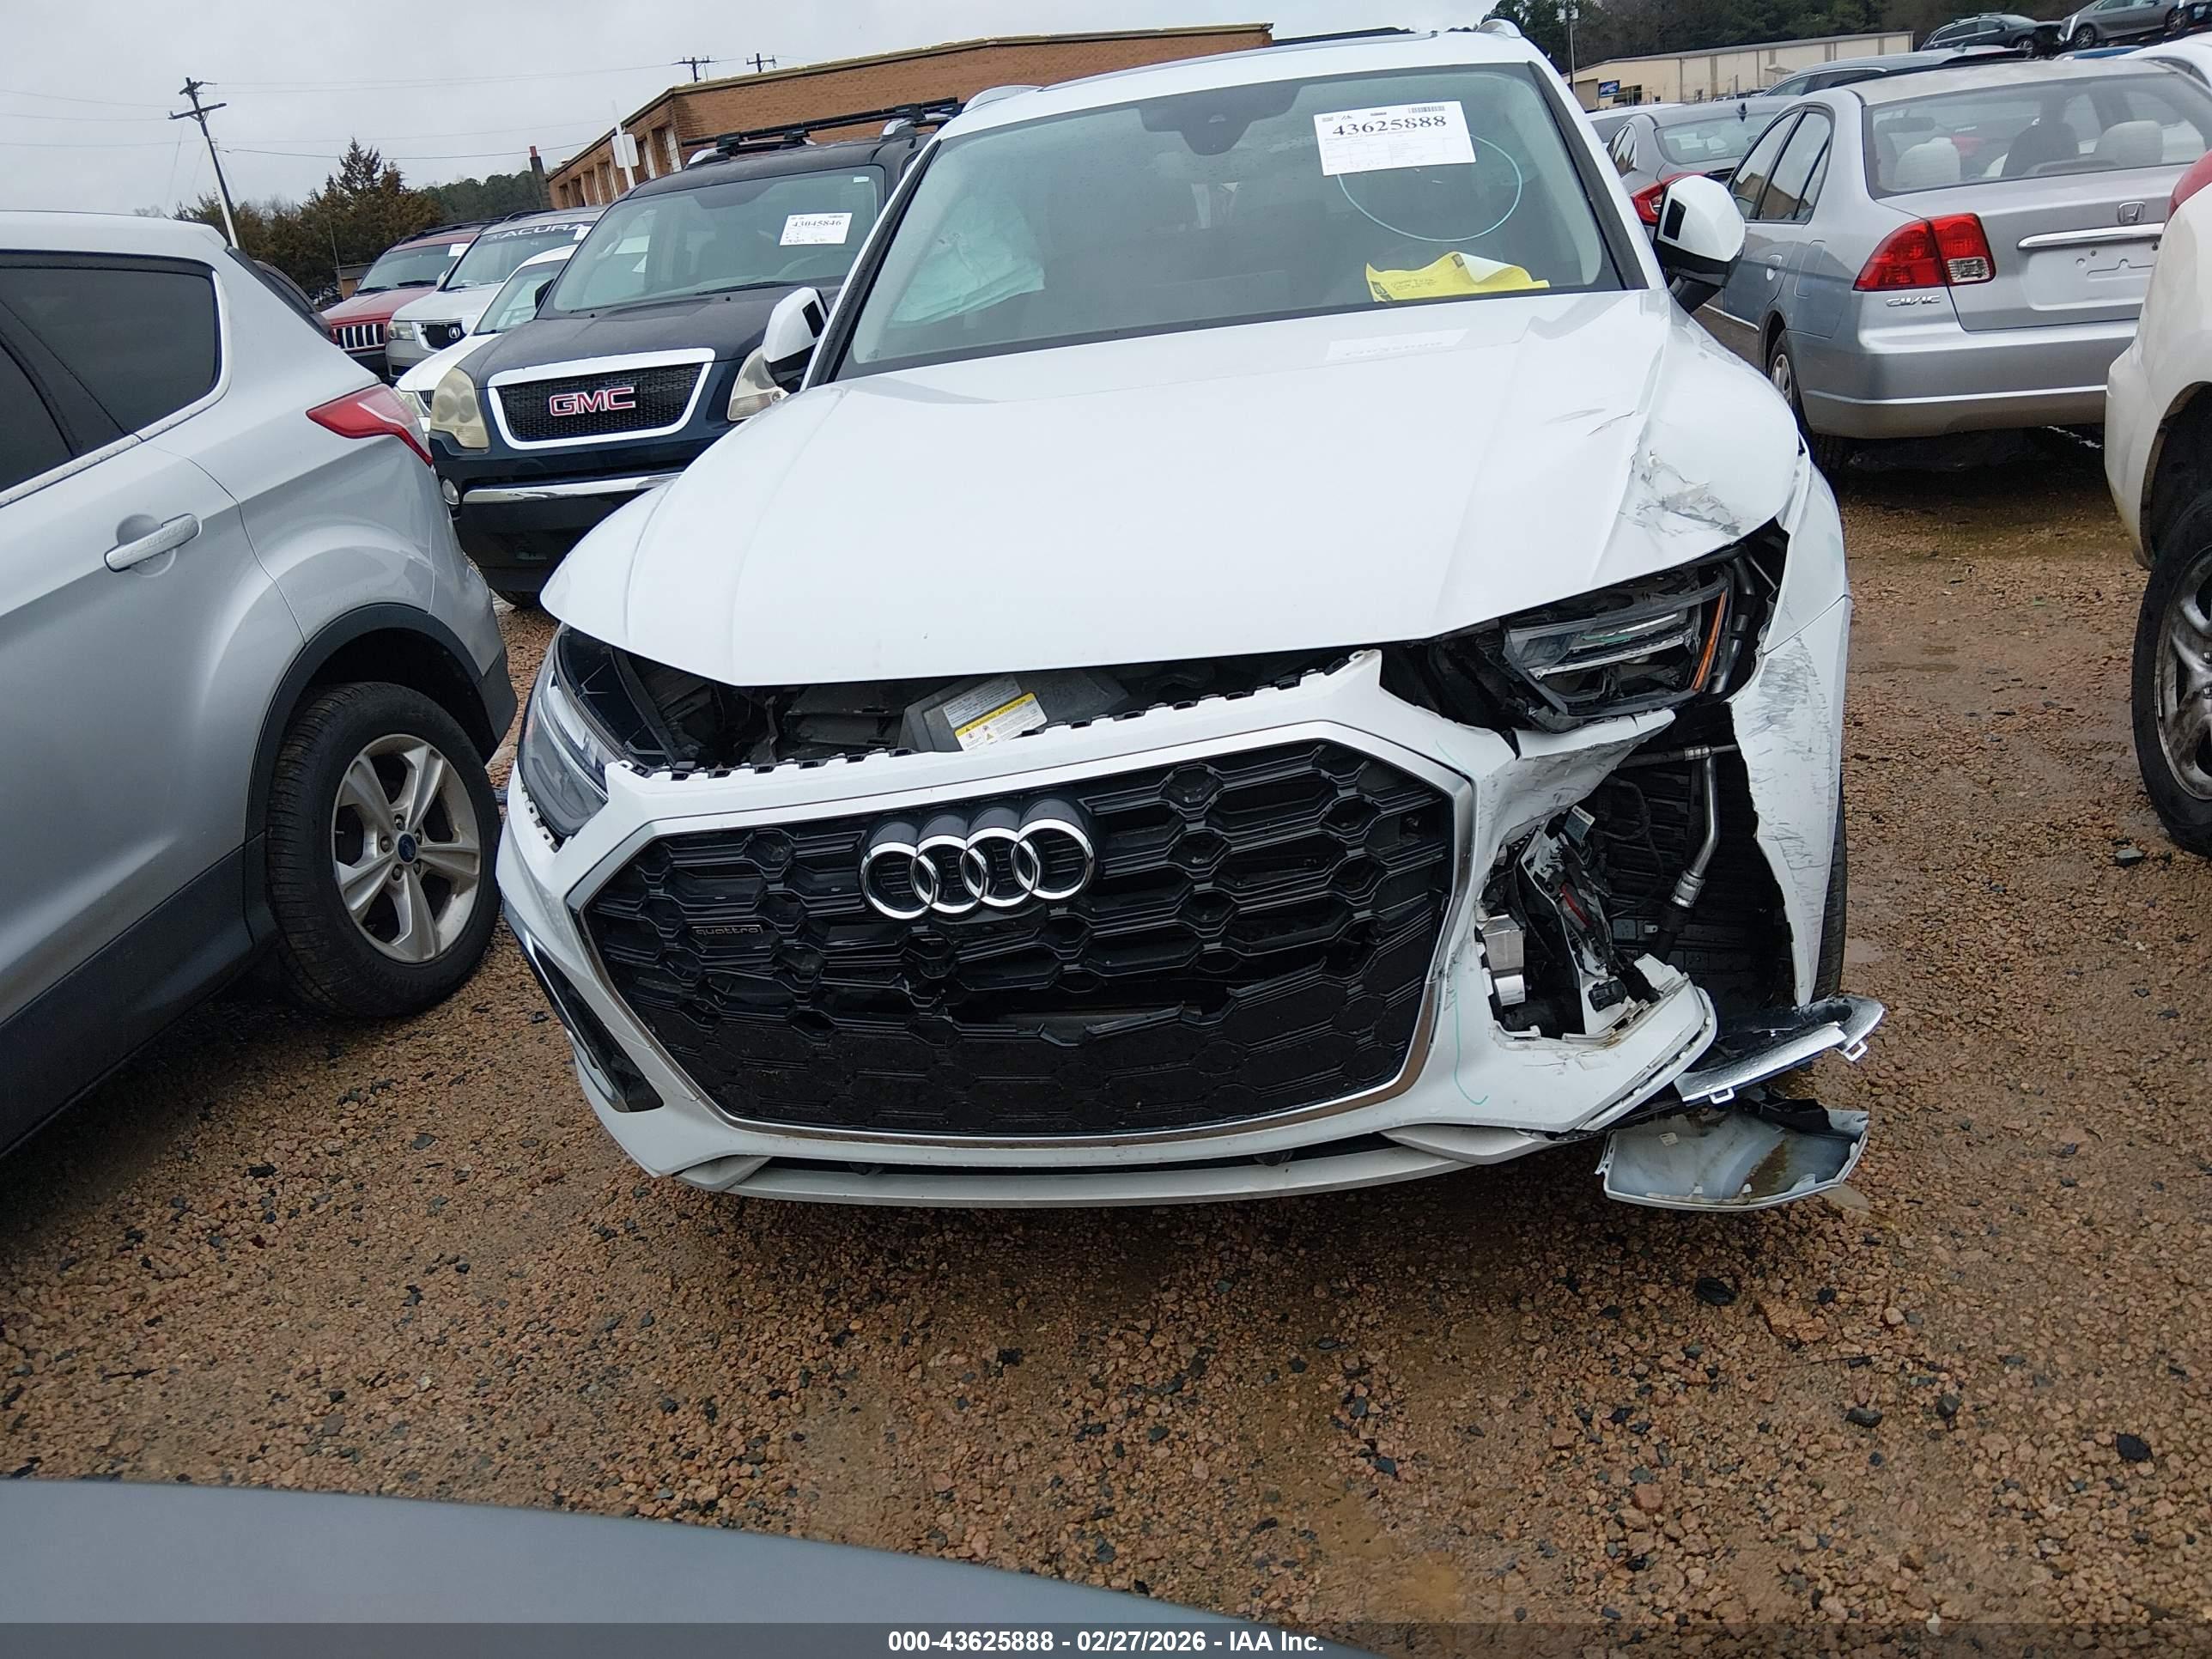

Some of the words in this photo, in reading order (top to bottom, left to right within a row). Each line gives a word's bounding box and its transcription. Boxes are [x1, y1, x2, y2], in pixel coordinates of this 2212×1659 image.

[1332, 115, 1448, 136] 43625888
[500, 223, 585, 240] ACURA
[1886, 295, 1941, 307] CIVIC
[550, 386, 636, 416] GMC
[696, 927, 759, 936] quattro
